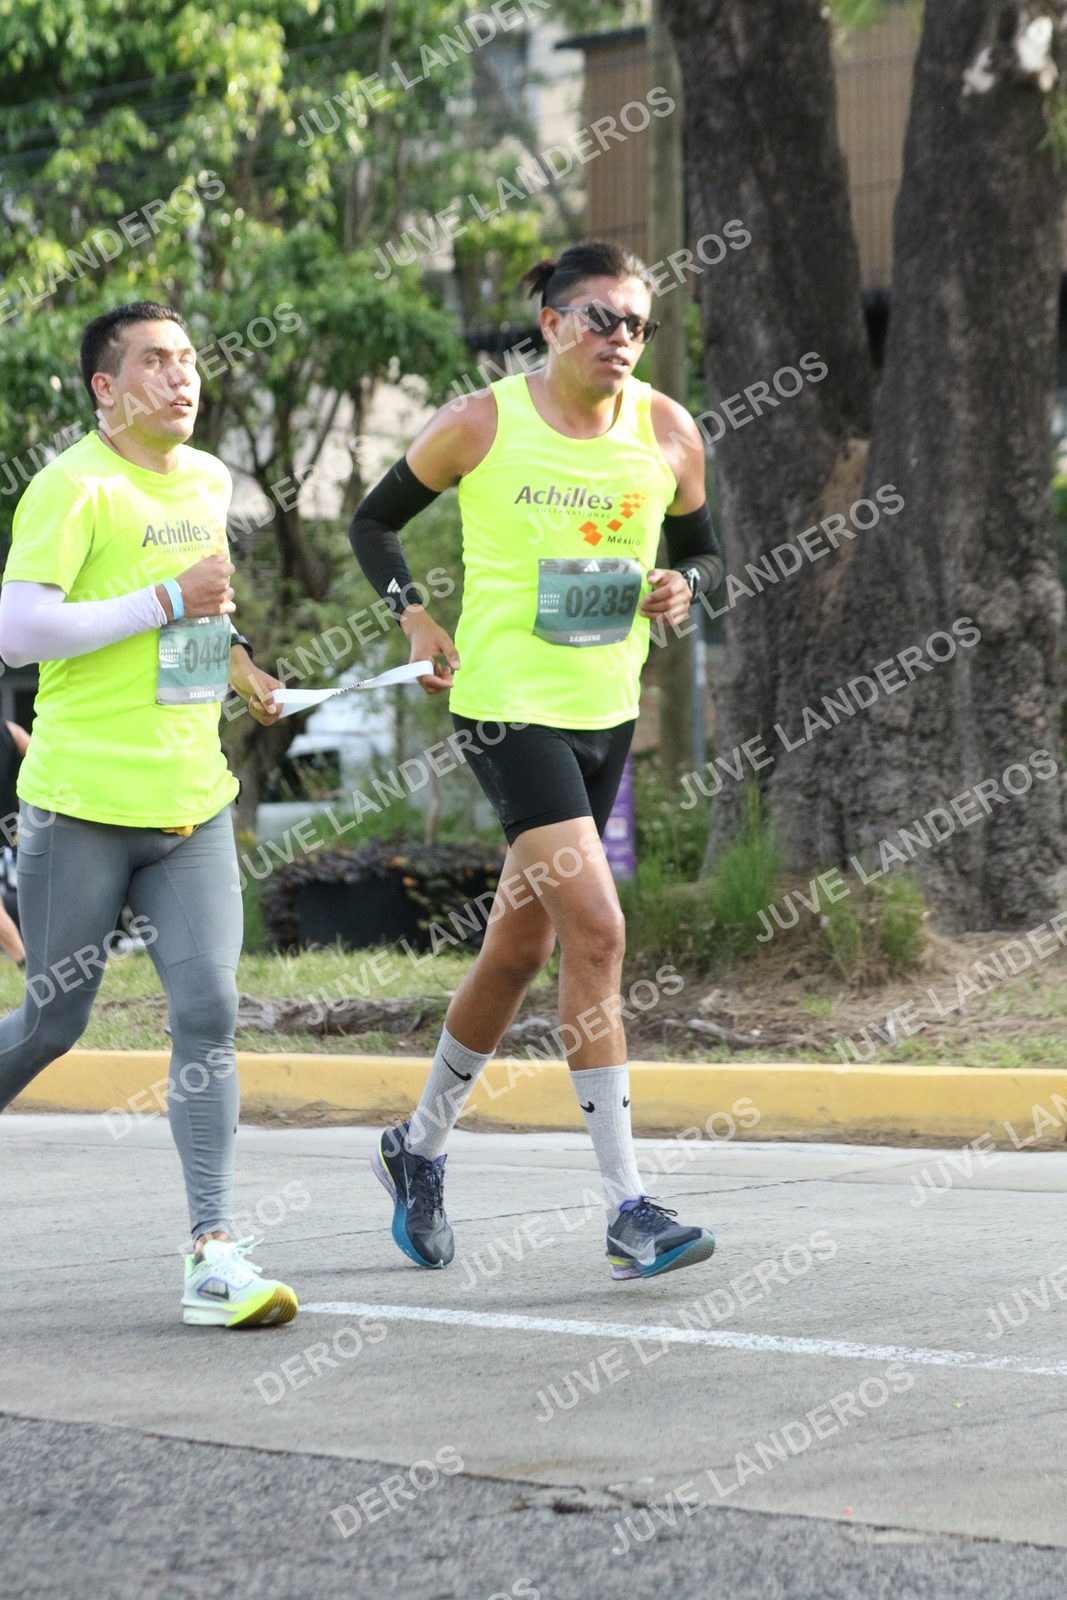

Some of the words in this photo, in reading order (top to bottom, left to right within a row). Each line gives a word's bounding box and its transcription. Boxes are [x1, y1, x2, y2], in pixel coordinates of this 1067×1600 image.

[514, 485, 613, 510] Achilles
[142, 519, 211, 547] Achilles
[565, 584, 636, 618] 0235
